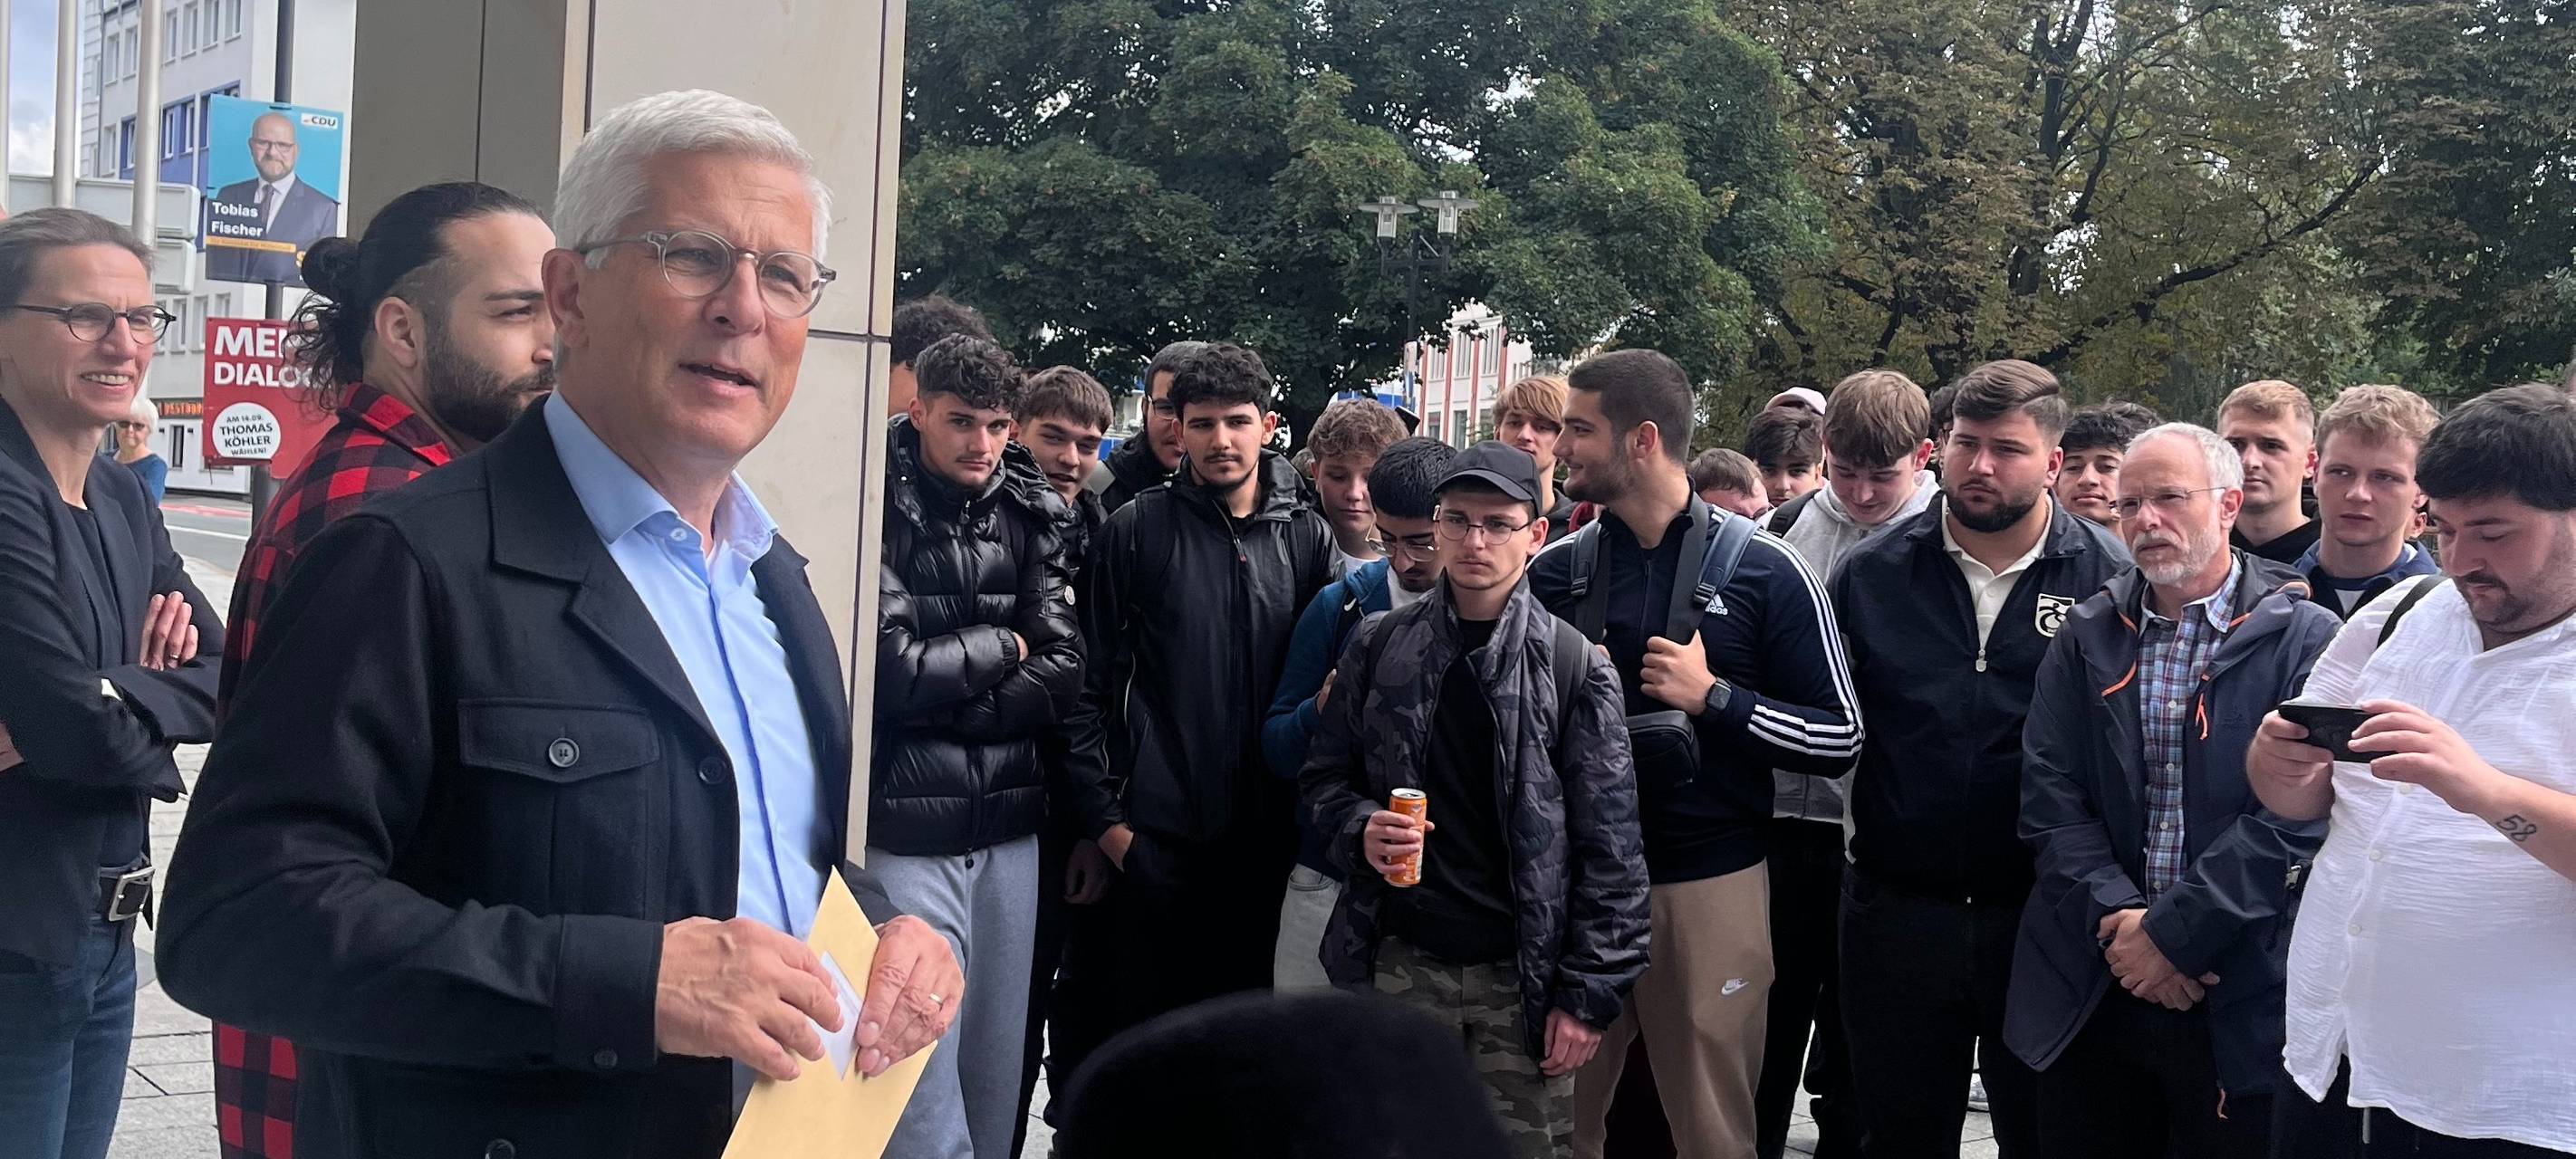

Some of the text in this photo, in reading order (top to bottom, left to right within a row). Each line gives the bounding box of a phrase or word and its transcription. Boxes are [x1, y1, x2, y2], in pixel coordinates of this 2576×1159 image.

[311, 115, 336, 127] CDU
[212, 201, 258, 218] Tobias
[211, 220, 263, 237] Fischer
[219, 423, 273, 436] THOMAS
[225, 435, 272, 447] KÖHLER
[2496, 814, 2537, 842] 58
